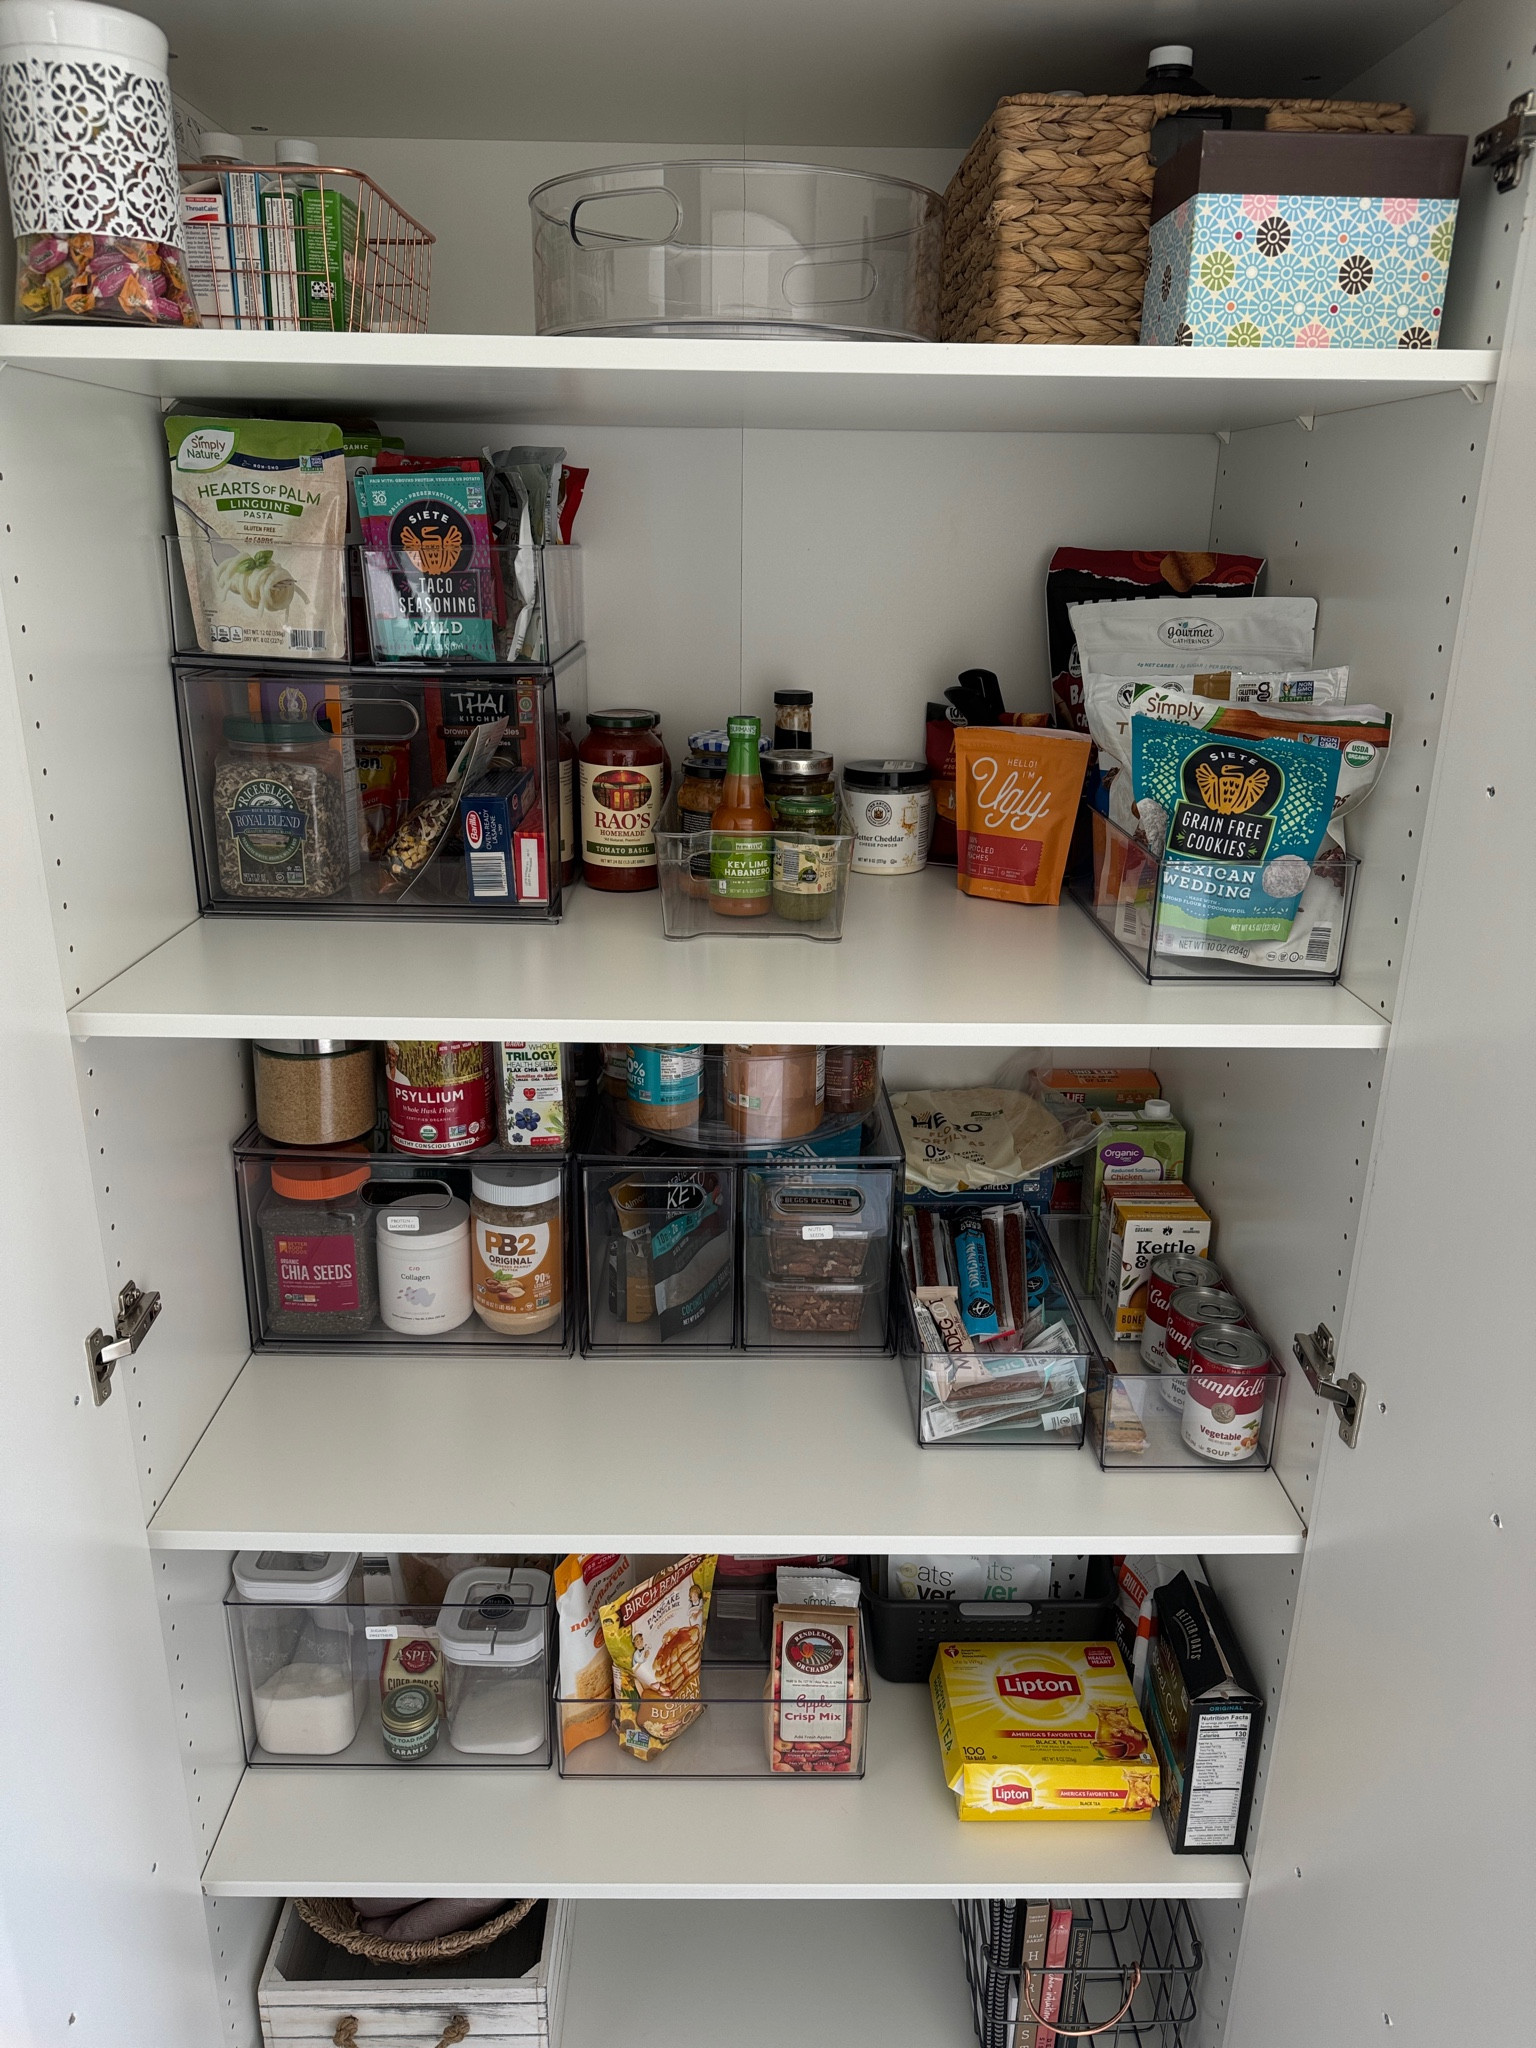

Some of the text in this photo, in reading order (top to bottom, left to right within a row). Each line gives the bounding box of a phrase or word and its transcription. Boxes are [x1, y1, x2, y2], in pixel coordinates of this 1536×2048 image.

[186, 204, 218, 212] ThroatCalm
[191, 438, 226, 453] Simply
[186, 448, 222, 460] Nature
[198, 482, 321, 506] HEARTS OF PALM
[230, 499, 291, 513] LINGUINE
[408, 490, 454, 503] PRESERVATIVE
[453, 499, 468, 514] FREE
[244, 511, 273, 520] PASTA
[408, 510, 450, 524] SIETE
[244, 525, 261, 533] GLUTEN
[418, 577, 453, 594] TACO
[399, 596, 476, 613] SEASONING
[413, 621, 464, 635] MILD
[1166, 626, 1215, 640] gourmet
[450, 691, 504, 715] THAI
[1146, 696, 1205, 721] Simply
[443, 727, 469, 736] brown
[1352, 744, 1369, 753] USDA
[1007, 758, 1038, 768] HELLO!
[1209, 751, 1259, 767] SIETE
[238, 782, 294, 806] RICESELECT
[971, 756, 1052, 832] Ugly
[235, 814, 301, 828] ROYAL BLEND
[470, 813, 480, 841] Barilla
[594, 810, 651, 830] RAO'S
[1182, 811, 1264, 841] GRAIN FREE
[482, 809, 492, 850] OVEN READY
[490, 815, 498, 844] LASAGNE
[600, 829, 646, 837] HOMEMADE
[874, 835, 904, 843] Cheddar
[1185, 832, 1247, 859] COOKIES
[595, 845, 650, 854] TOMATO BASIL
[727, 859, 769, 869] KEY LIME
[1165, 856, 1256, 884] MEXICAN
[724, 867, 771, 877] HABANERO
[1162, 871, 1252, 899] WEDDING
[1183, 898, 1202, 907] FLOUR
[1207, 904, 1236, 914] COCONUT
[1178, 940, 1192, 950] NET
[1193, 941, 1206, 951] WT
[1207, 943, 1215, 952] 10
[1215, 944, 1227, 953] OZ
[528, 1043, 557, 1051] WHOLE
[506, 1051, 557, 1061] TRILOGY
[534, 1060, 558, 1068] SEEDS
[395, 1087, 464, 1104] PSYLLIUM
[402, 1104, 456, 1114] Whole Husk Fiber
[452, 1138, 473, 1148] LIVING
[1104, 1149, 1140, 1158] Organic
[1110, 1173, 1143, 1181] Chicken
[484, 1229, 536, 1257] PB2
[1135, 1240, 1196, 1255] Kettle
[489, 1255, 533, 1265] ORIGINAL
[965, 1241, 981, 1289] ORIGINAL
[1134, 1255, 1149, 1269] &
[281, 1263, 353, 1281] CHIA SEEDS
[400, 1273, 431, 1282] Collagen
[534, 1272, 551, 1284] 90%
[1121, 1314, 1143, 1324] BONE
[1190, 1363, 1265, 1399] Campbell's
[1199, 1424, 1242, 1441] Vegetable
[1206, 1446, 1230, 1458] SOUP
[622, 1588, 659, 1622] BIRCH
[647, 1592, 680, 1626] PANCAKE
[794, 1630, 836, 1644] RENDLEMAN
[1175, 1608, 1202, 1660] BETTER OATS
[392, 1648, 439, 1662] ASPEN
[796, 1661, 834, 1673] ORCHARDS
[1004, 1678, 1074, 1696] Lipton
[796, 1693, 833, 1714] Apple
[784, 1712, 842, 1723] Crisp Mix
[391, 1744, 429, 1756] CARAMEL
[963, 1746, 985, 1756] 100
[995, 1788, 1029, 1801] Lipton
